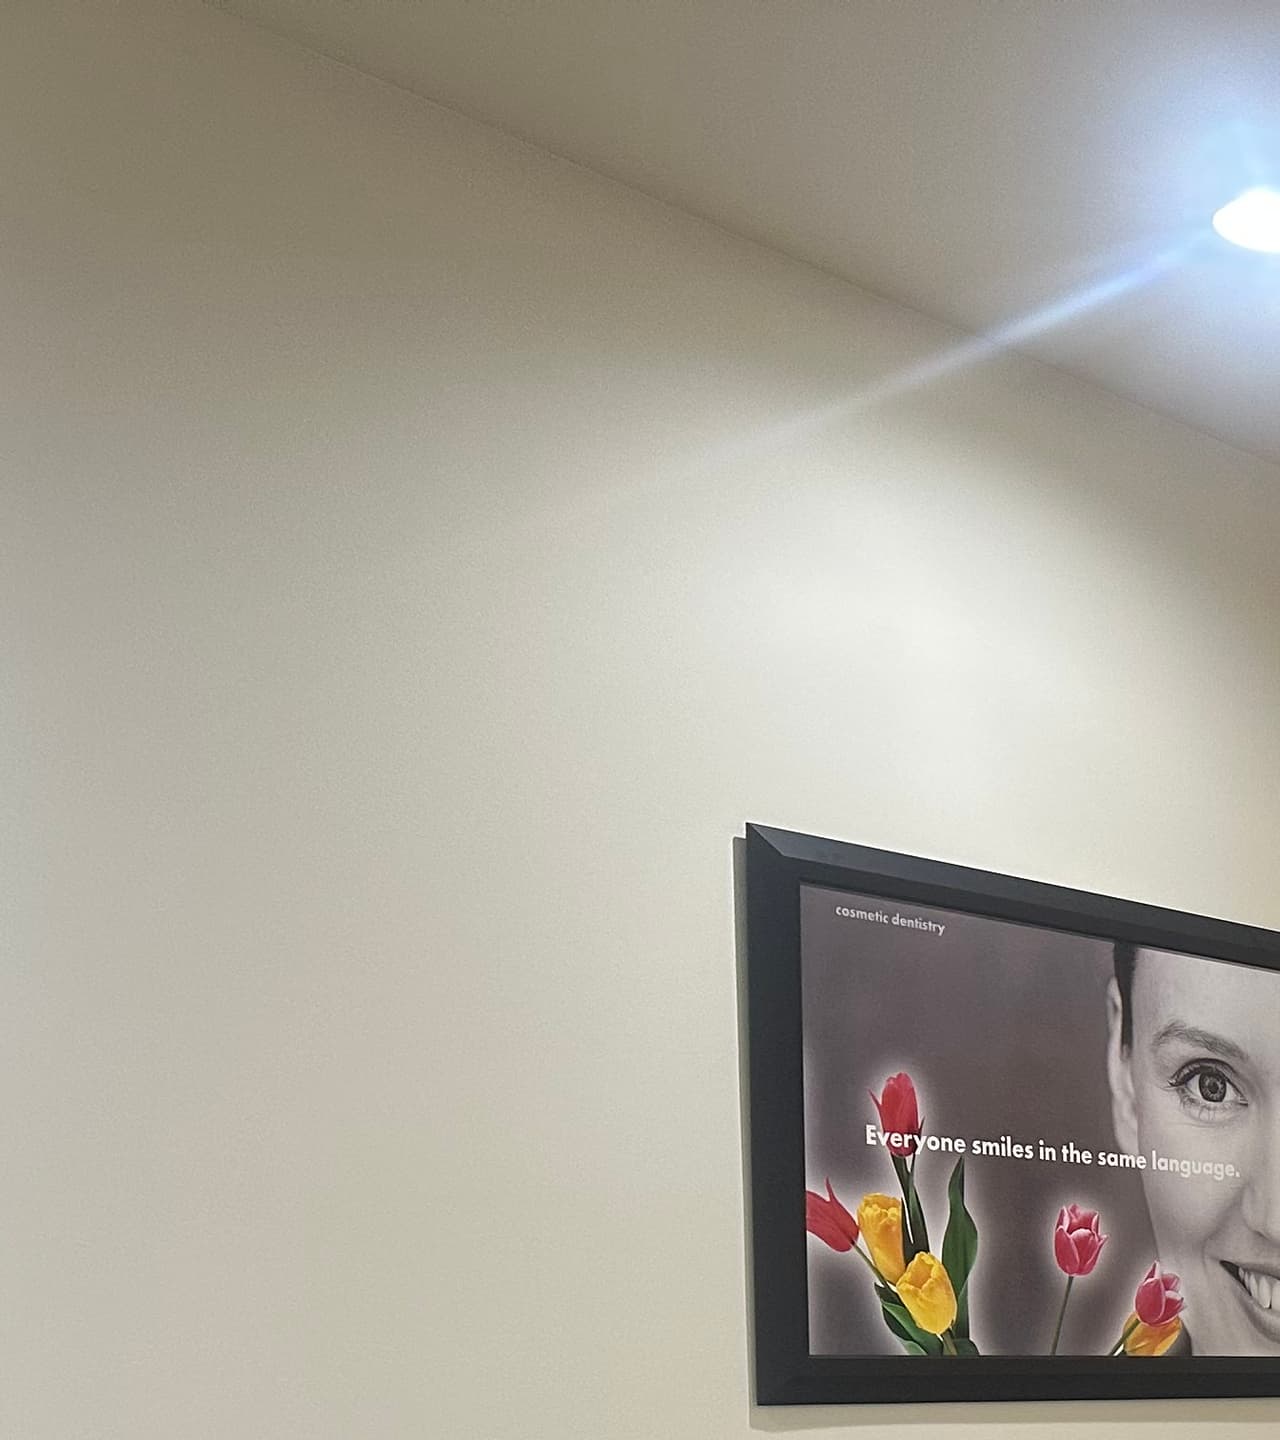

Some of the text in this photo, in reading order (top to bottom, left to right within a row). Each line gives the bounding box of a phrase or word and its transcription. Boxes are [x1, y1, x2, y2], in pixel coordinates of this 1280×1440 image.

[835, 905, 946, 936] cosmetic dentistry
[865, 1125, 1241, 1181] Everyone smiles in the same language.
